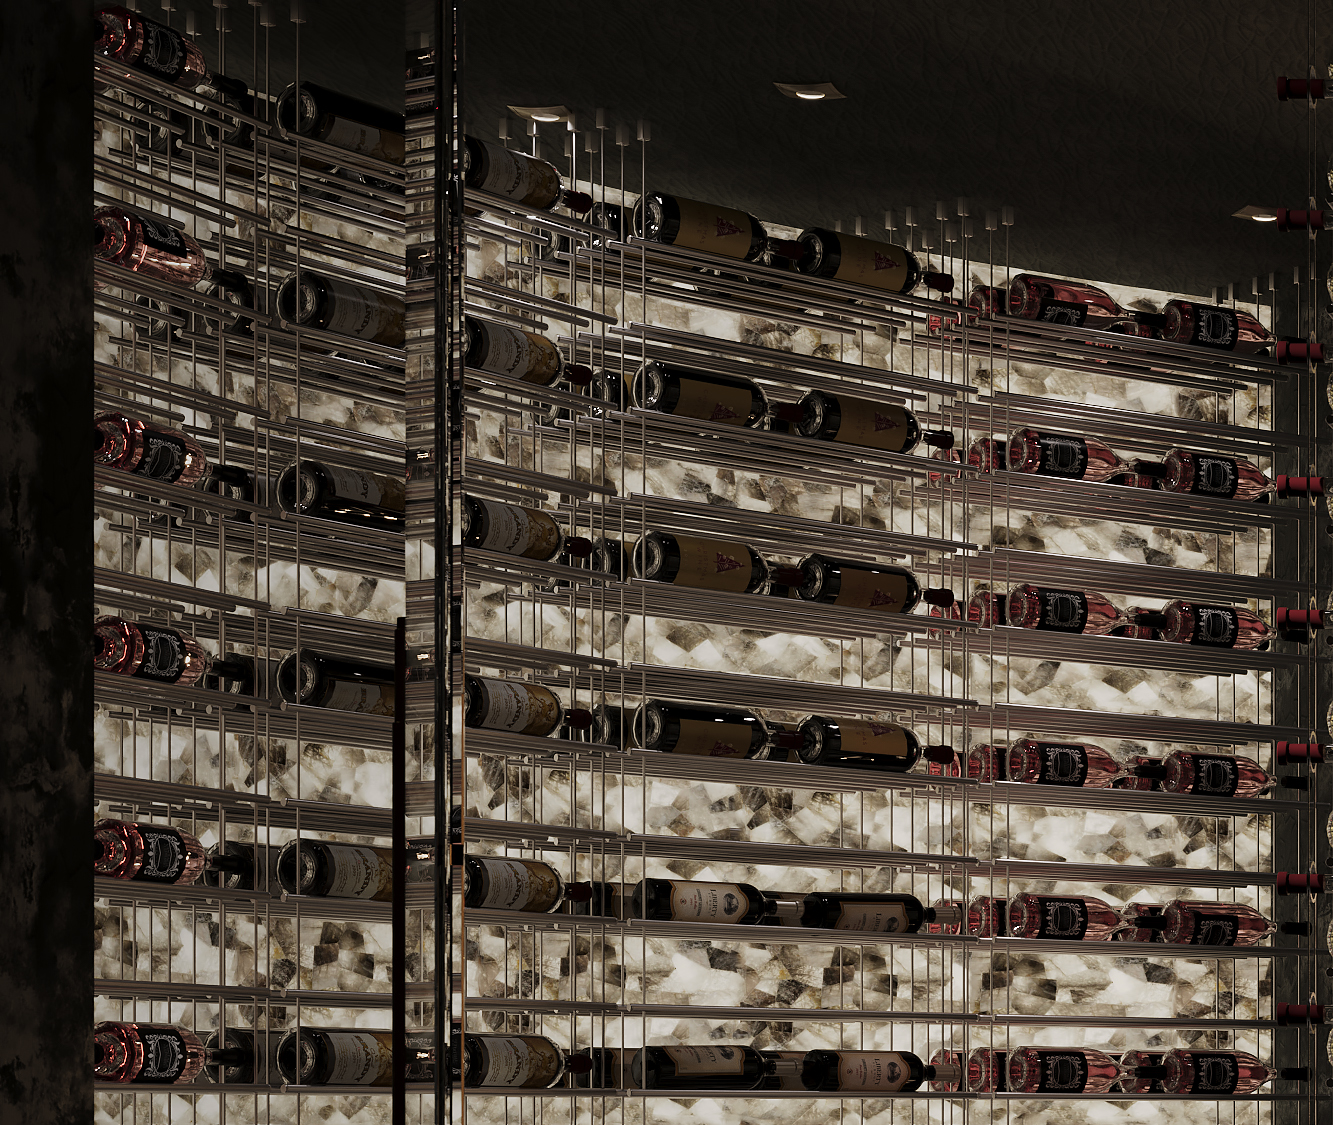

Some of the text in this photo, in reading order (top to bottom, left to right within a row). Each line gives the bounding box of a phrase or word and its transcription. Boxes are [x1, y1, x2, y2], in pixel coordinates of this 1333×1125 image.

[505, 151, 521, 196] BRANDY
[505, 329, 521, 374] BRANDY
[505, 506, 521, 552] BRANDY
[506, 683, 522, 729] BRANDY
[355, 849, 370, 896] BRANDY
[506, 863, 522, 908] BRANDY
[710, 889, 718, 917] LIBERTY
[355, 1036, 370, 1082] BRANDY
[506, 1039, 522, 1085] BRANDY
[874, 1058, 882, 1086] LIBERTY
